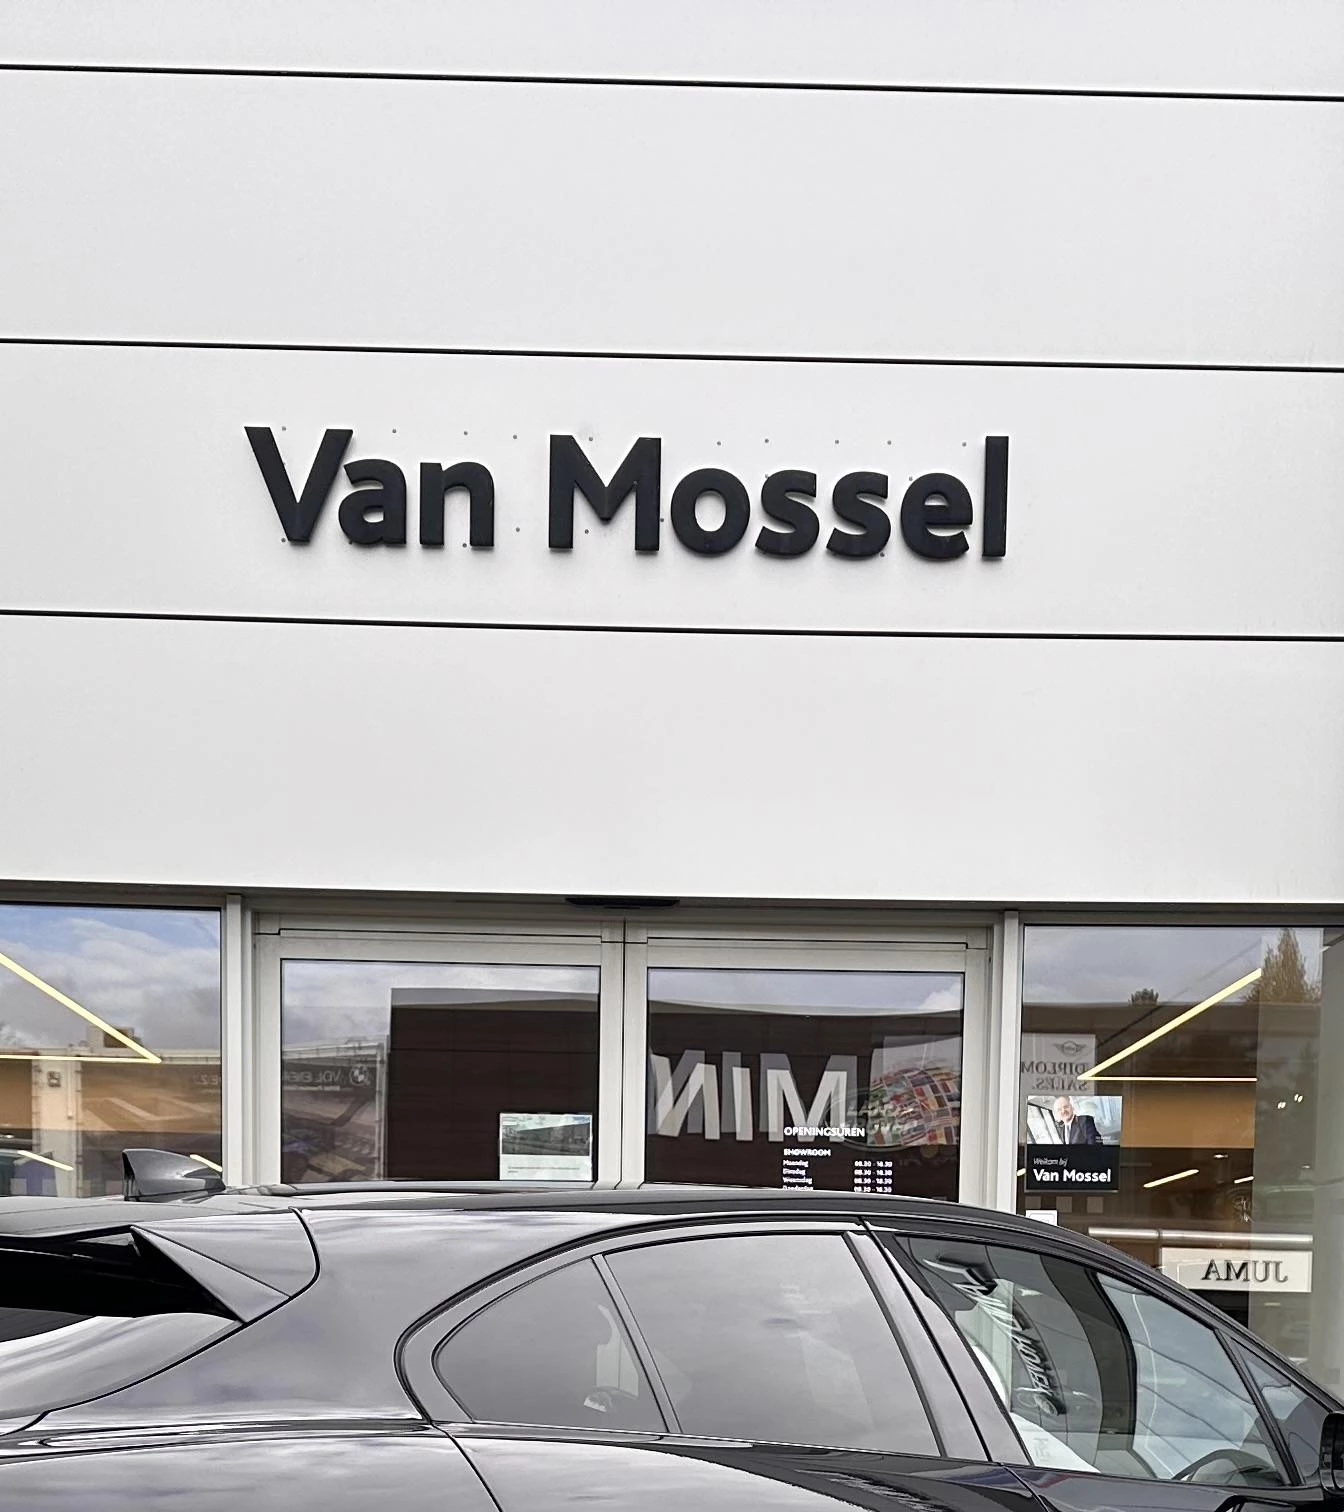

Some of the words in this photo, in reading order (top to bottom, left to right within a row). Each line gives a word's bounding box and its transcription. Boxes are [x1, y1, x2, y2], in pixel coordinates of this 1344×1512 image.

[244, 426, 494, 547] Van
[549, 434, 1008, 560] Mossel
[783, 1126, 866, 1137] OPENINGSUREN
[1032, 1168, 1060, 1182] Van
[1062, 1168, 1112, 1182] Mossel
